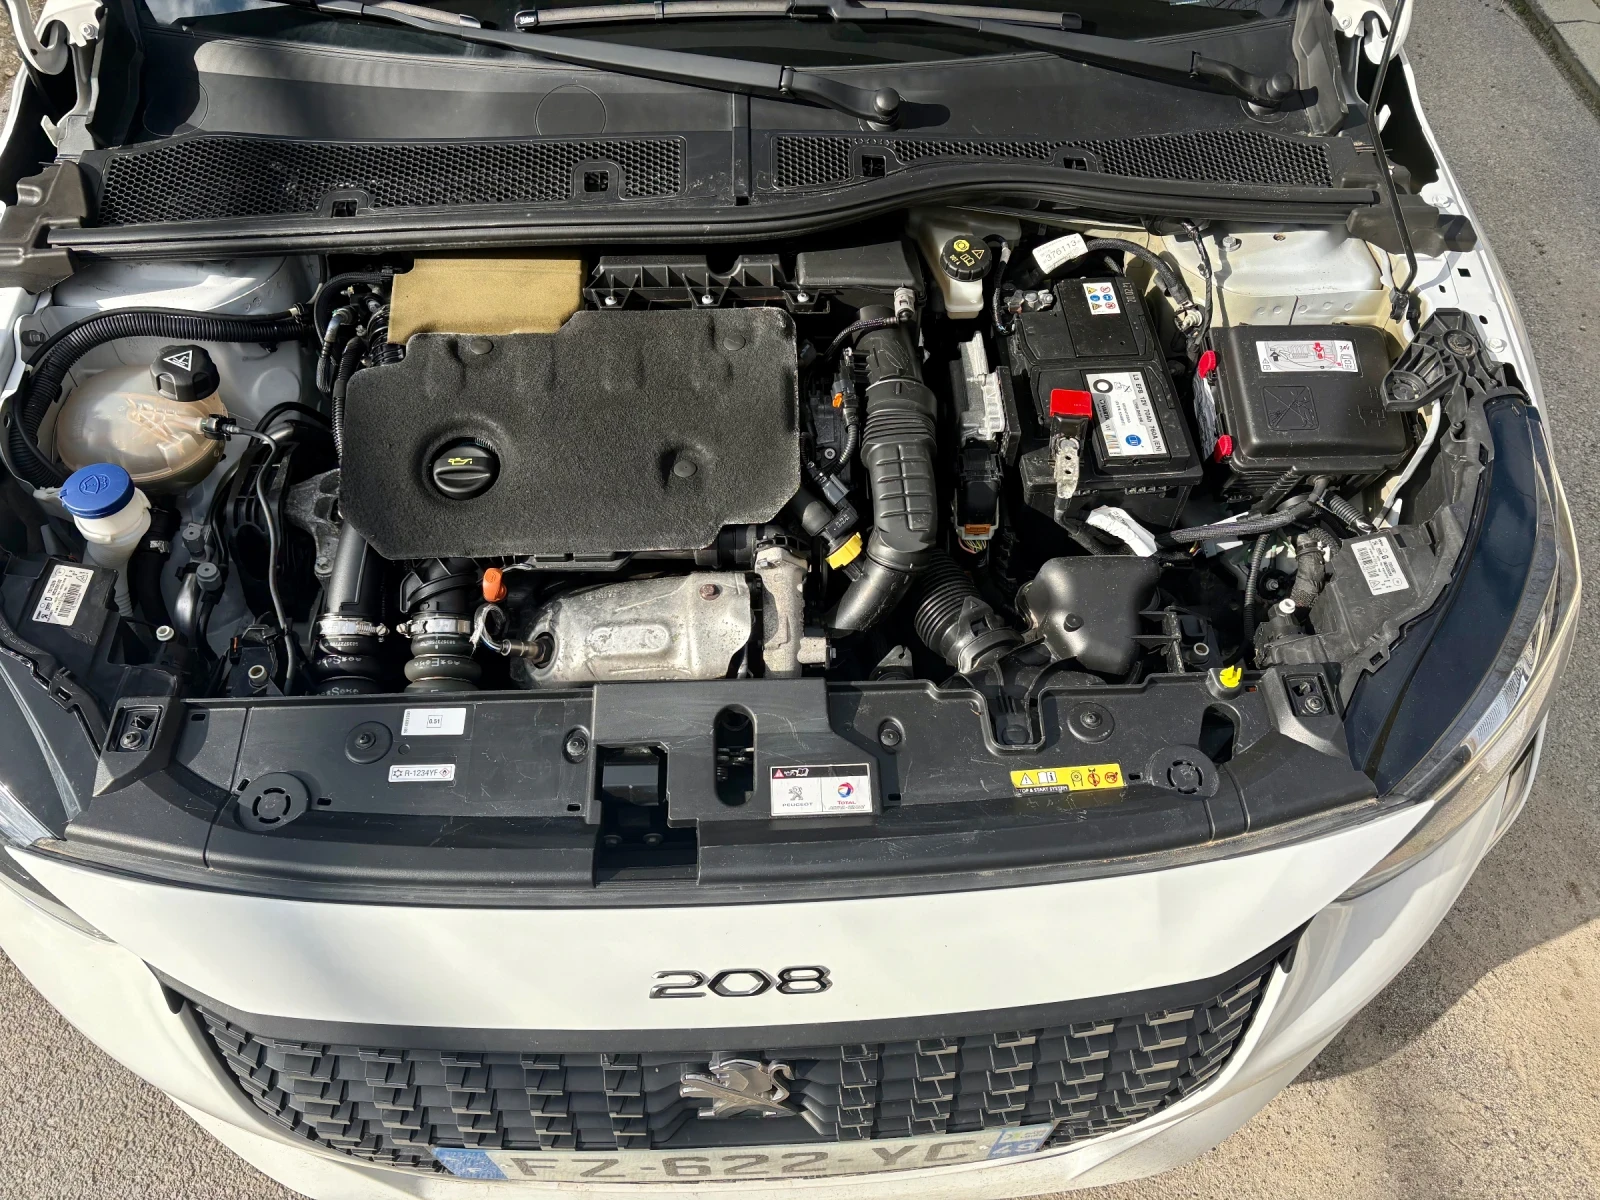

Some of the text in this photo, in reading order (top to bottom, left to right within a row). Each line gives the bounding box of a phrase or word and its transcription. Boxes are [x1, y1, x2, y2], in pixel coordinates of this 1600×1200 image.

[1045, 239, 1077, 262] 376113
[1100, 402, 1111, 421] VARTA
[1139, 396, 1149, 407] 12V
[404, 768, 438, 777] R-1234YF
[649, 965, 834, 999] 208
[510, 1139, 977, 1178] FZ-622-YC
